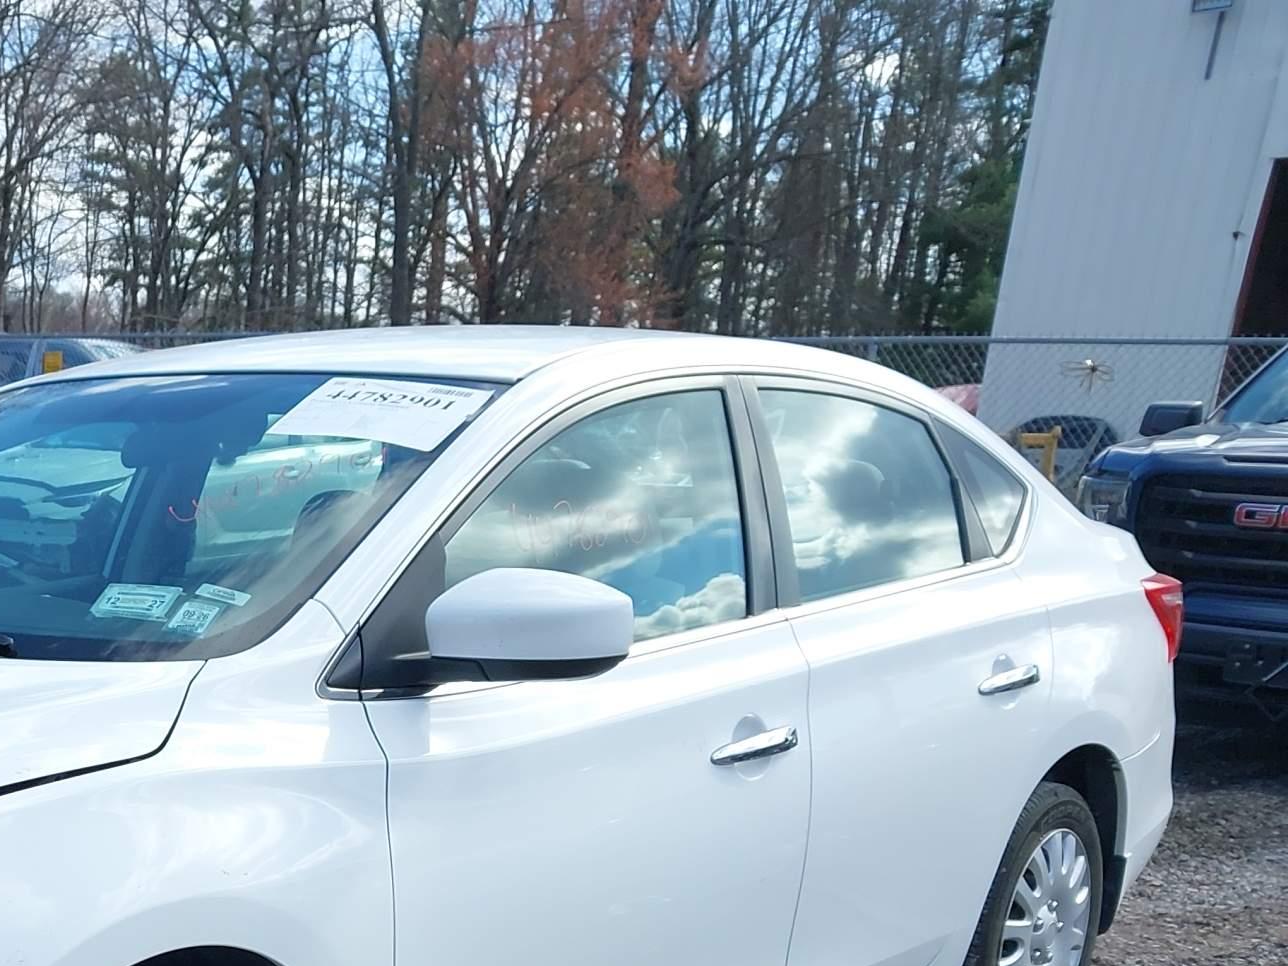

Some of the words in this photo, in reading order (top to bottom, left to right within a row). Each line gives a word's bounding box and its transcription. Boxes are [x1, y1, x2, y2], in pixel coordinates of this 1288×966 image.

[1234, 503, 1288, 528] G
[105, 595, 120, 605] 12
[148, 599, 166, 609] 27
[182, 609, 196, 618] 09
